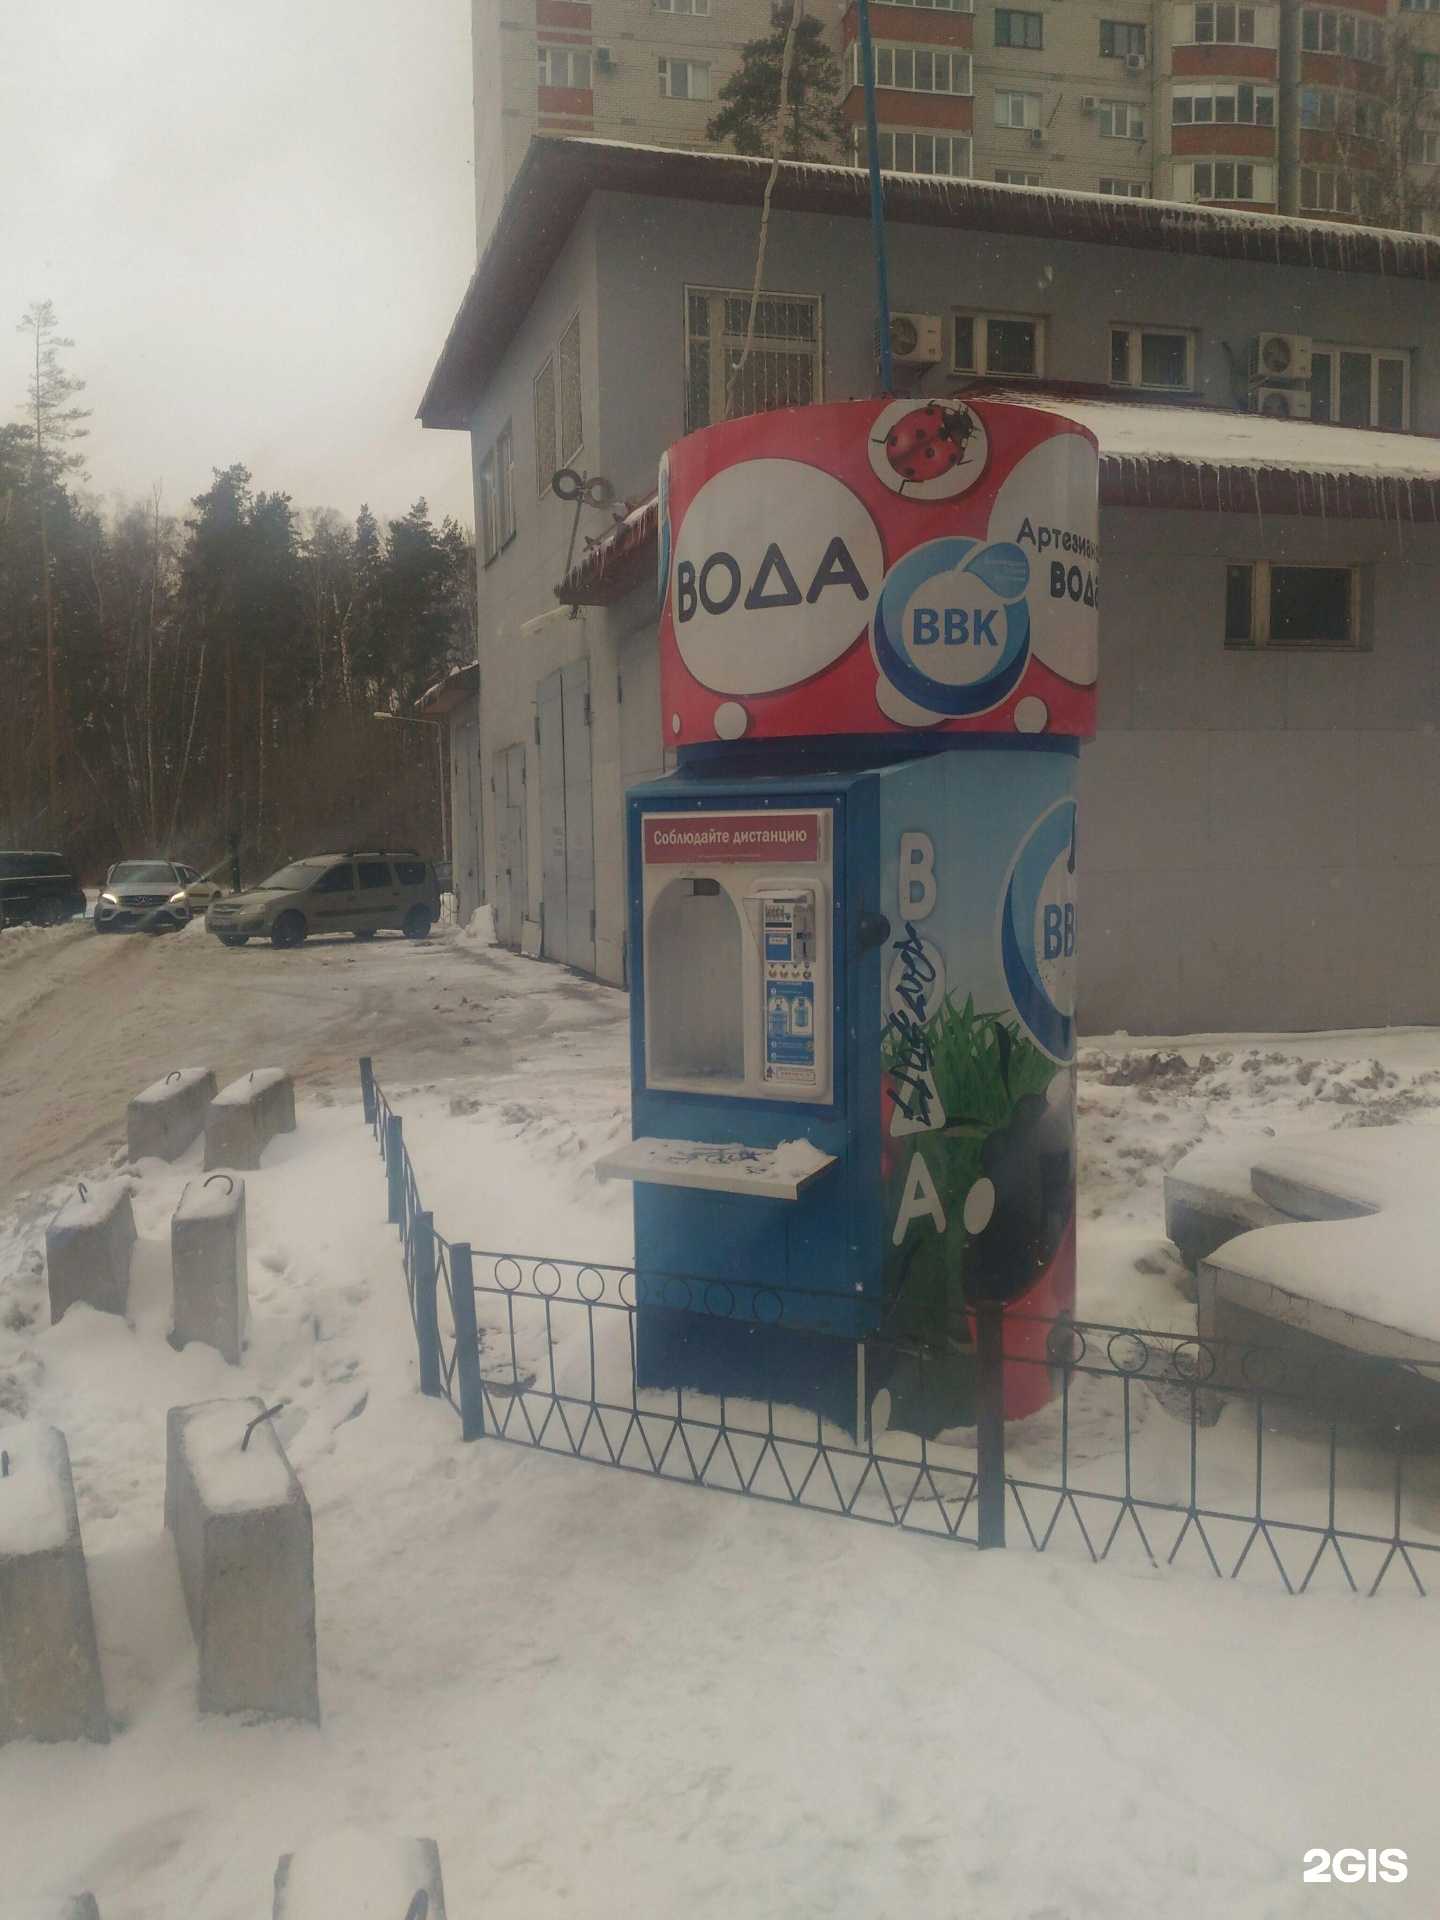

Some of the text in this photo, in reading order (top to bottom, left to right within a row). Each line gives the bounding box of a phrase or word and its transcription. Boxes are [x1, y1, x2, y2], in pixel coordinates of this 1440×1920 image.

[678, 536, 870, 624] ВОДА
[912, 607, 999, 647] ВВК
[653, 828, 808, 846] Соблюдайте дистанцию
[1043, 902, 1076, 961] ВВ
